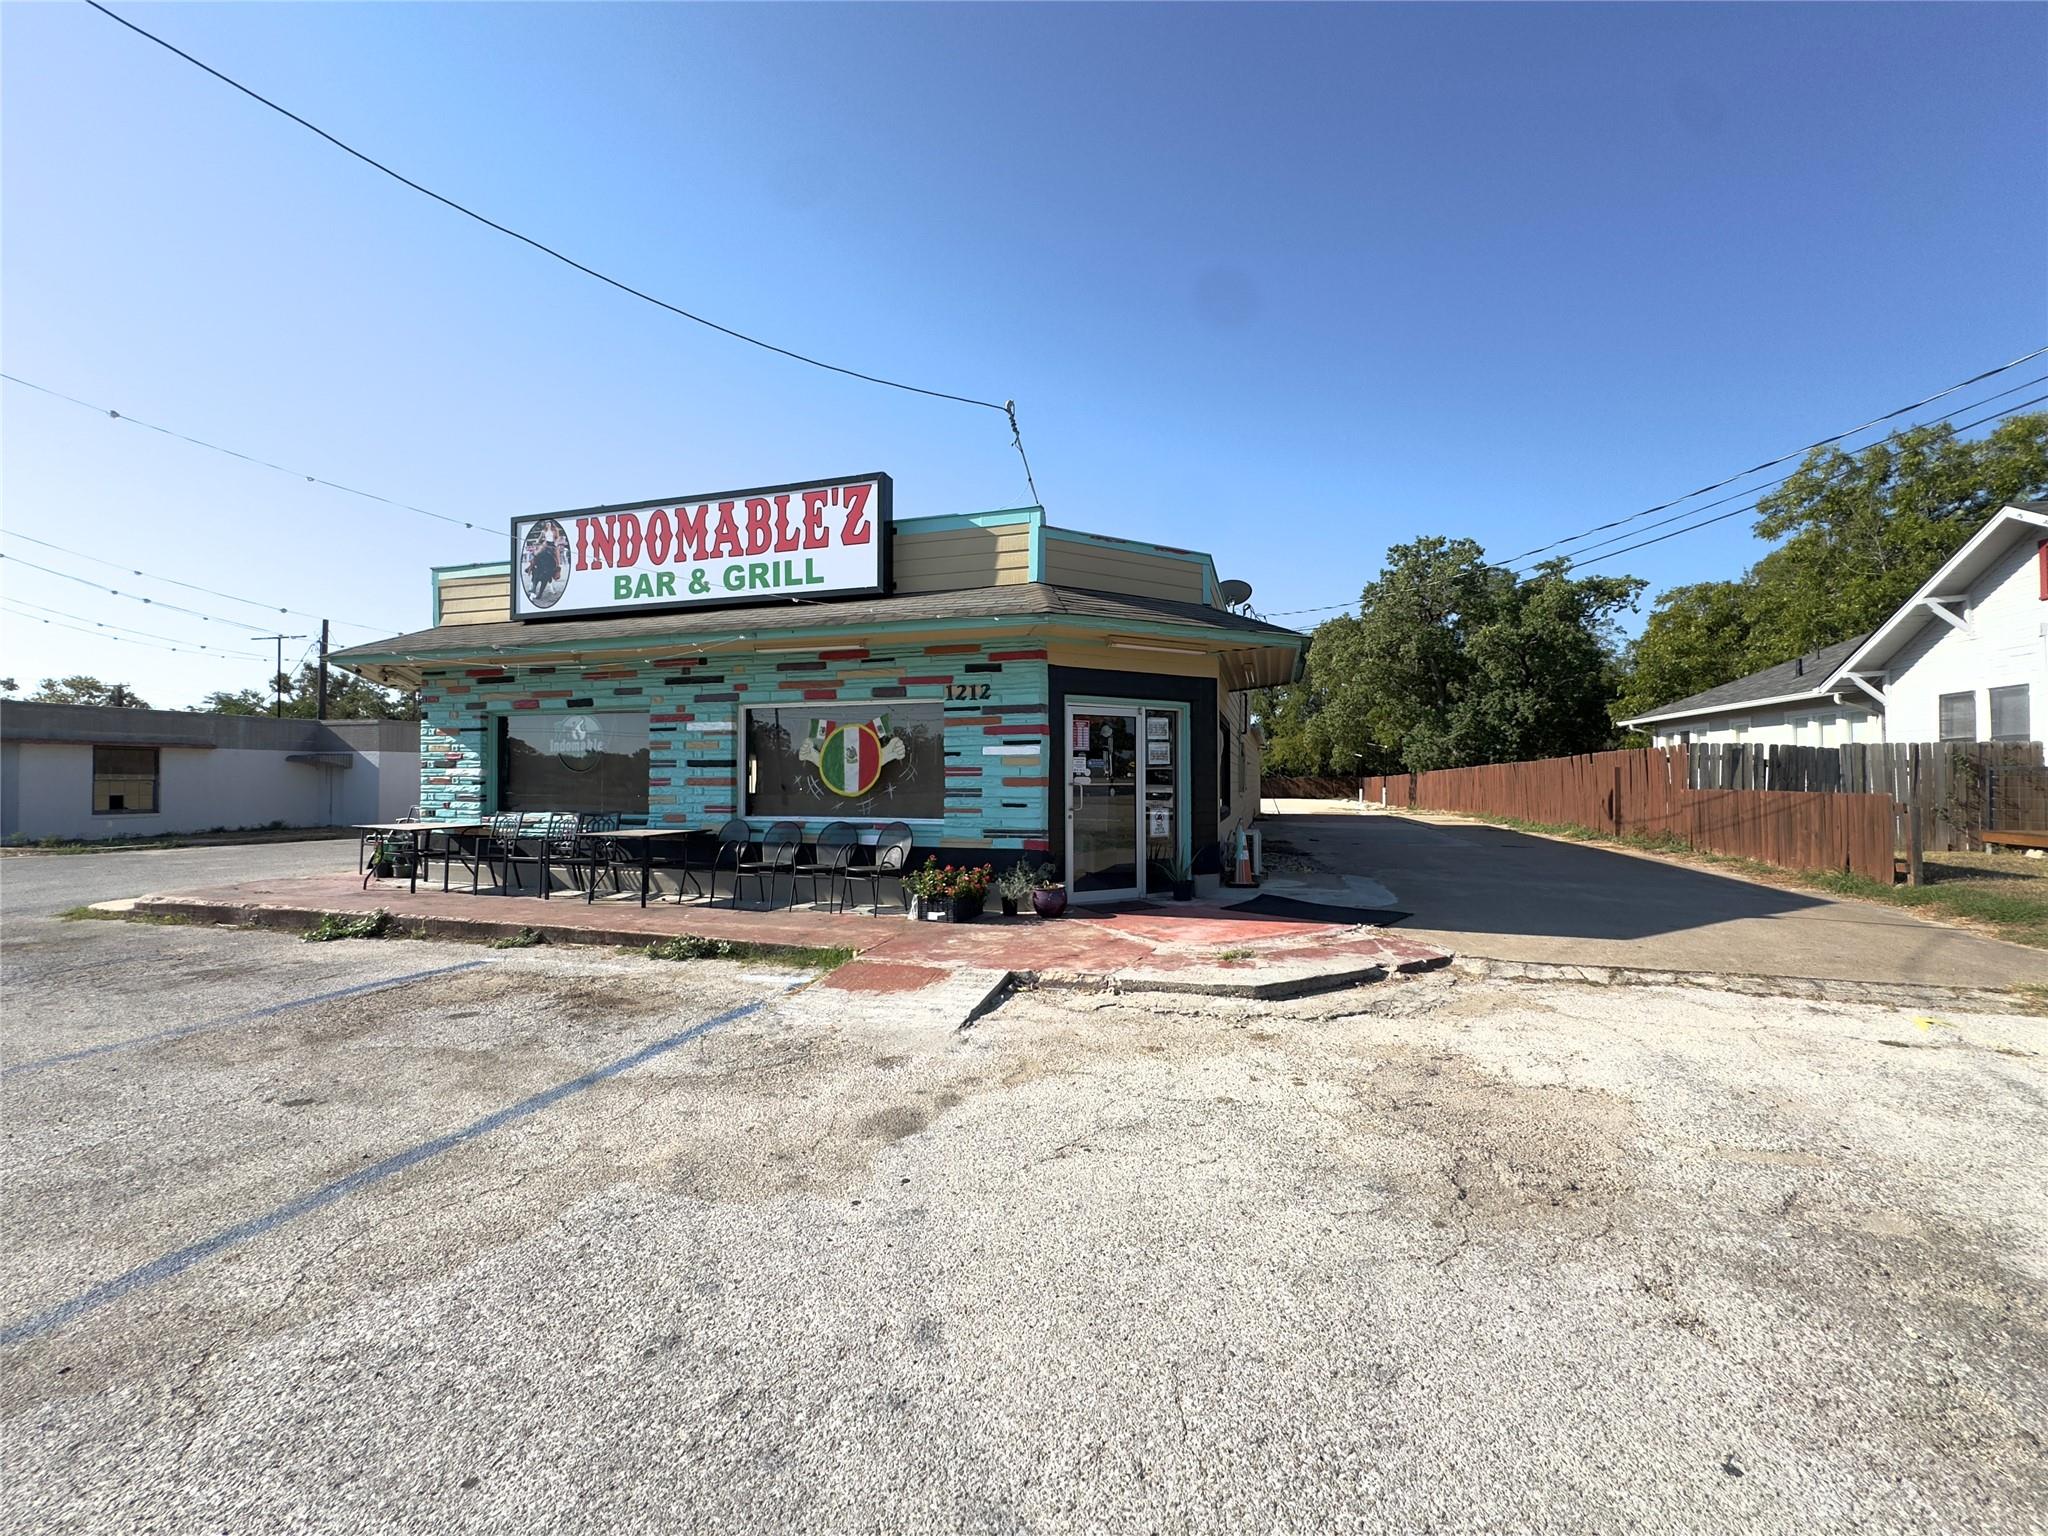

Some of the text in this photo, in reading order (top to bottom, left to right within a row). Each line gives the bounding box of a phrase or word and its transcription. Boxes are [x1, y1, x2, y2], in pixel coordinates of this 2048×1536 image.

[575, 484, 872, 572] INDOMABLE'Z
[614, 558, 824, 600] BAR & GRILL
[945, 683, 992, 701] 1212
